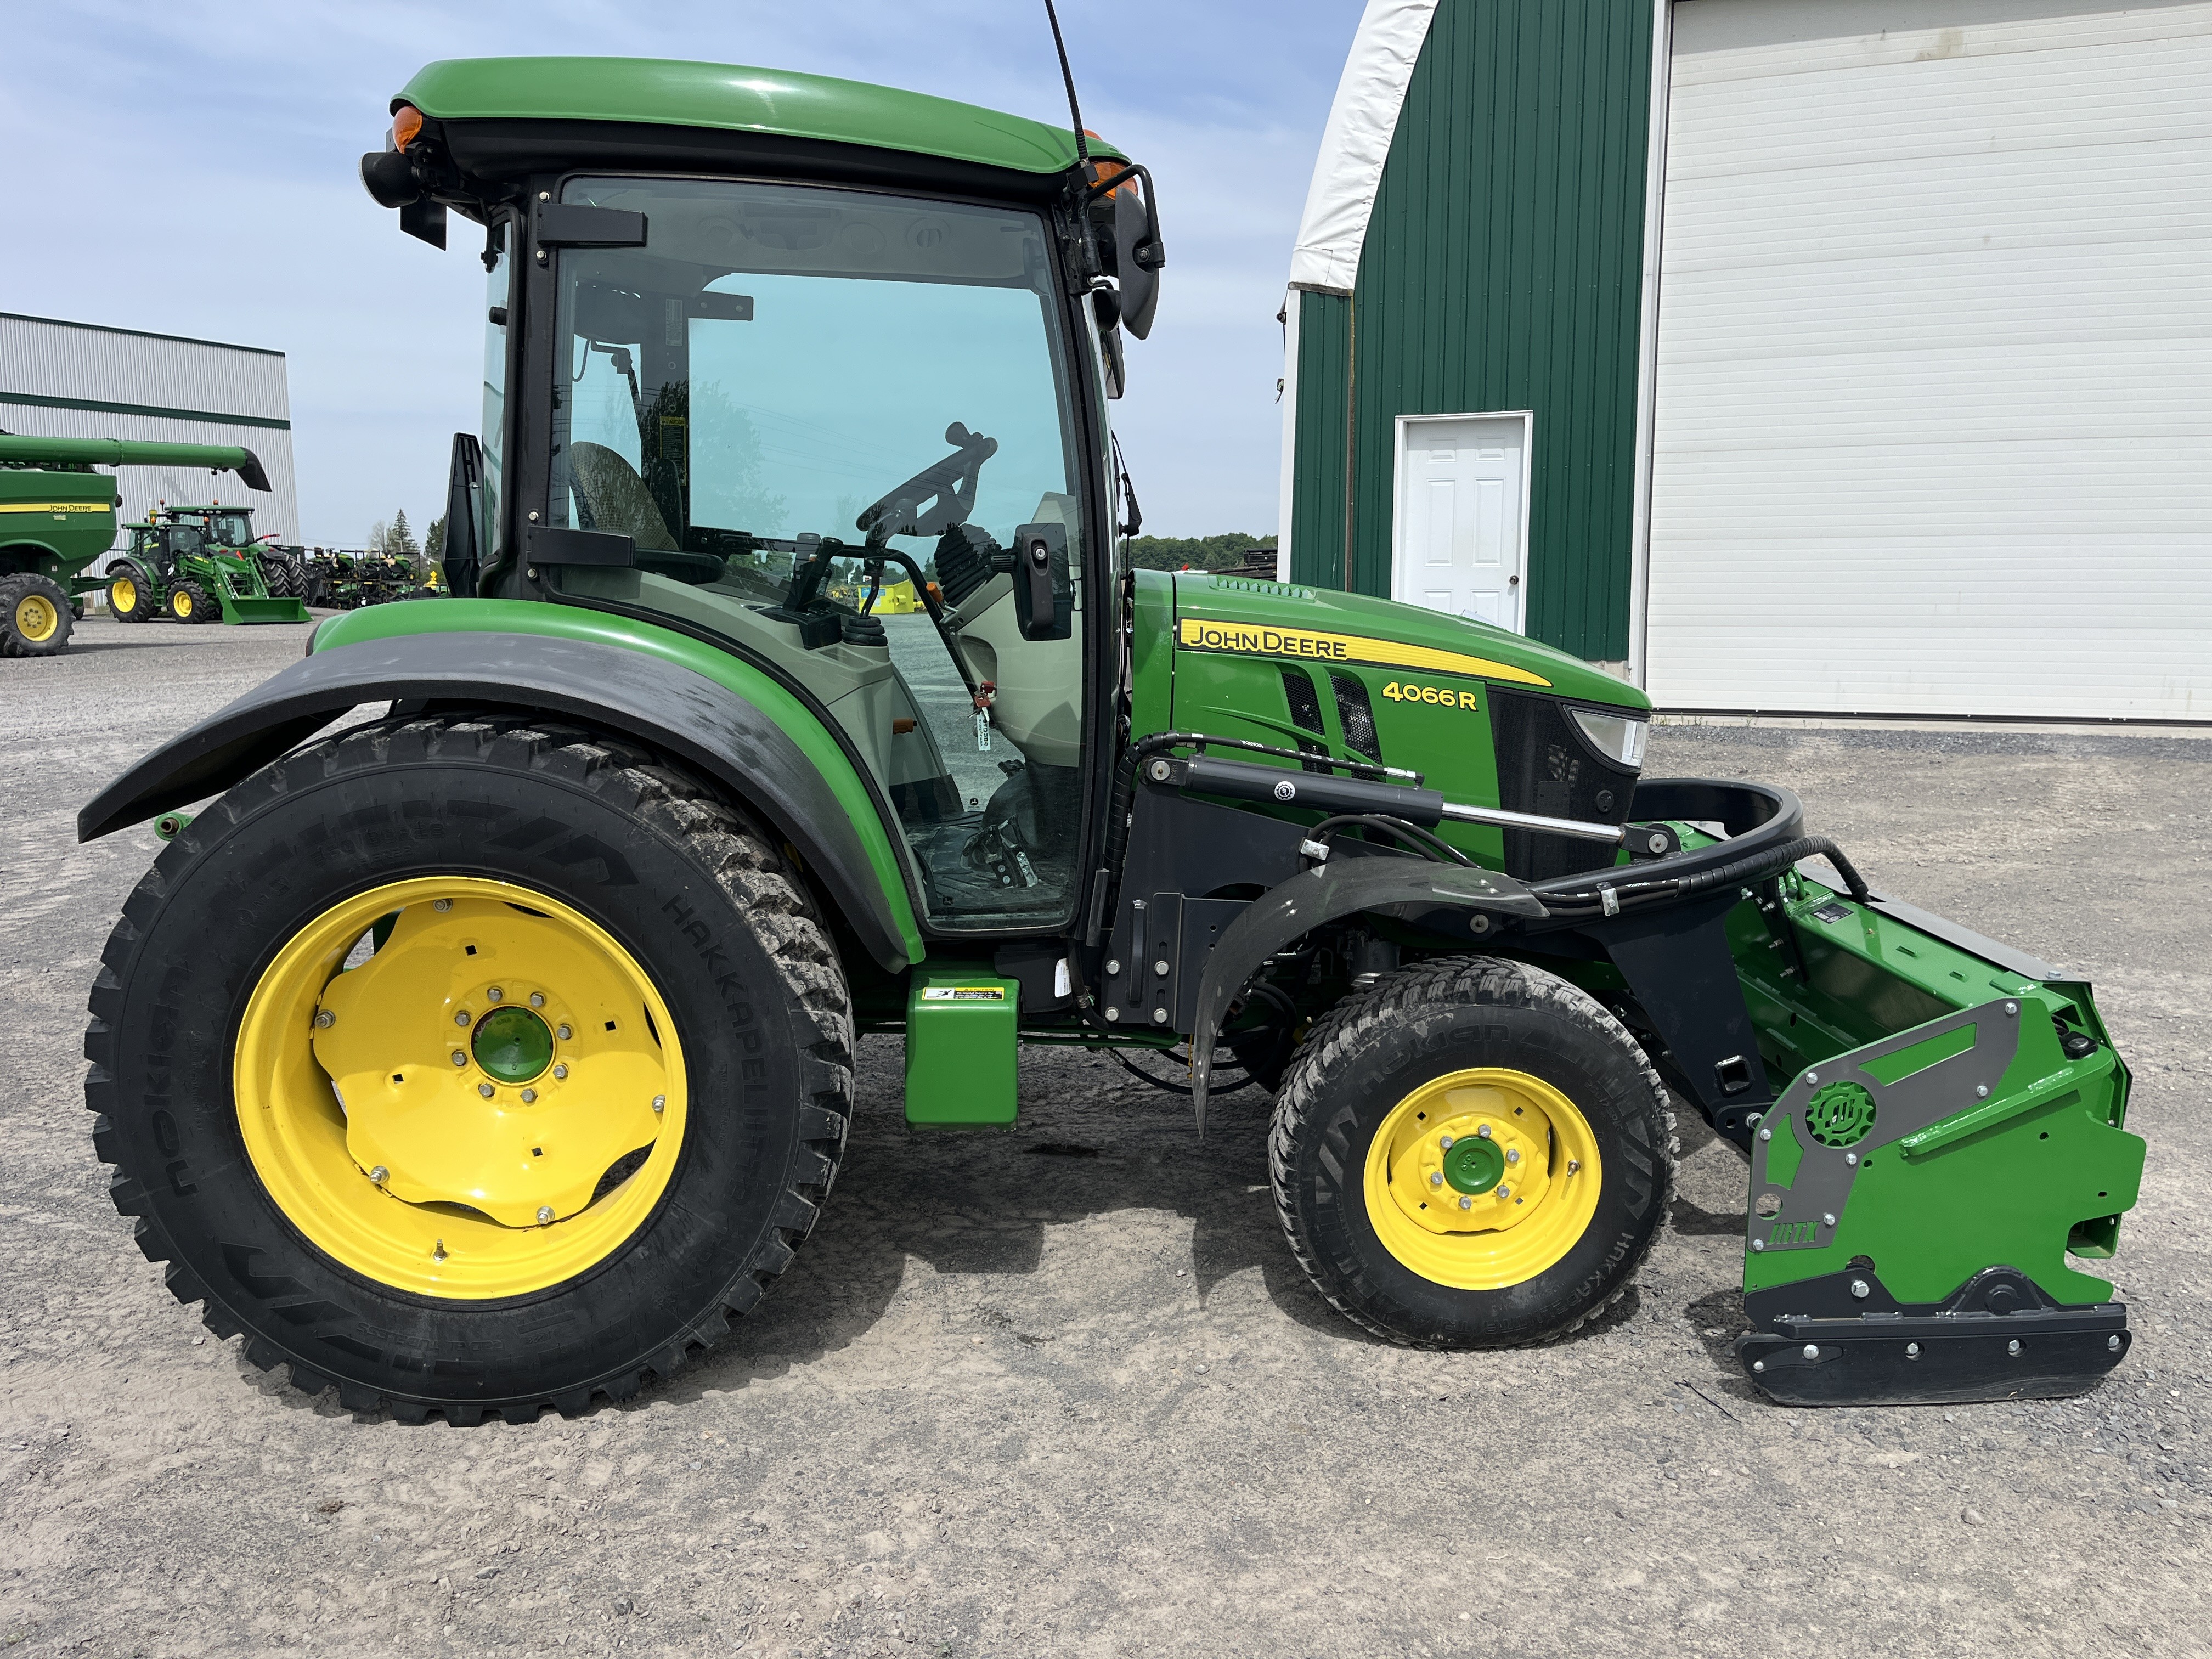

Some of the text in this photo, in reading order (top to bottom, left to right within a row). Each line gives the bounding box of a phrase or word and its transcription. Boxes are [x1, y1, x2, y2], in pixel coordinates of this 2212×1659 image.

[1190, 625, 1347, 658] JOHN DEERE
[1382, 681, 1477, 712] 4066R
[719, 1070, 729, 1093] MADE
